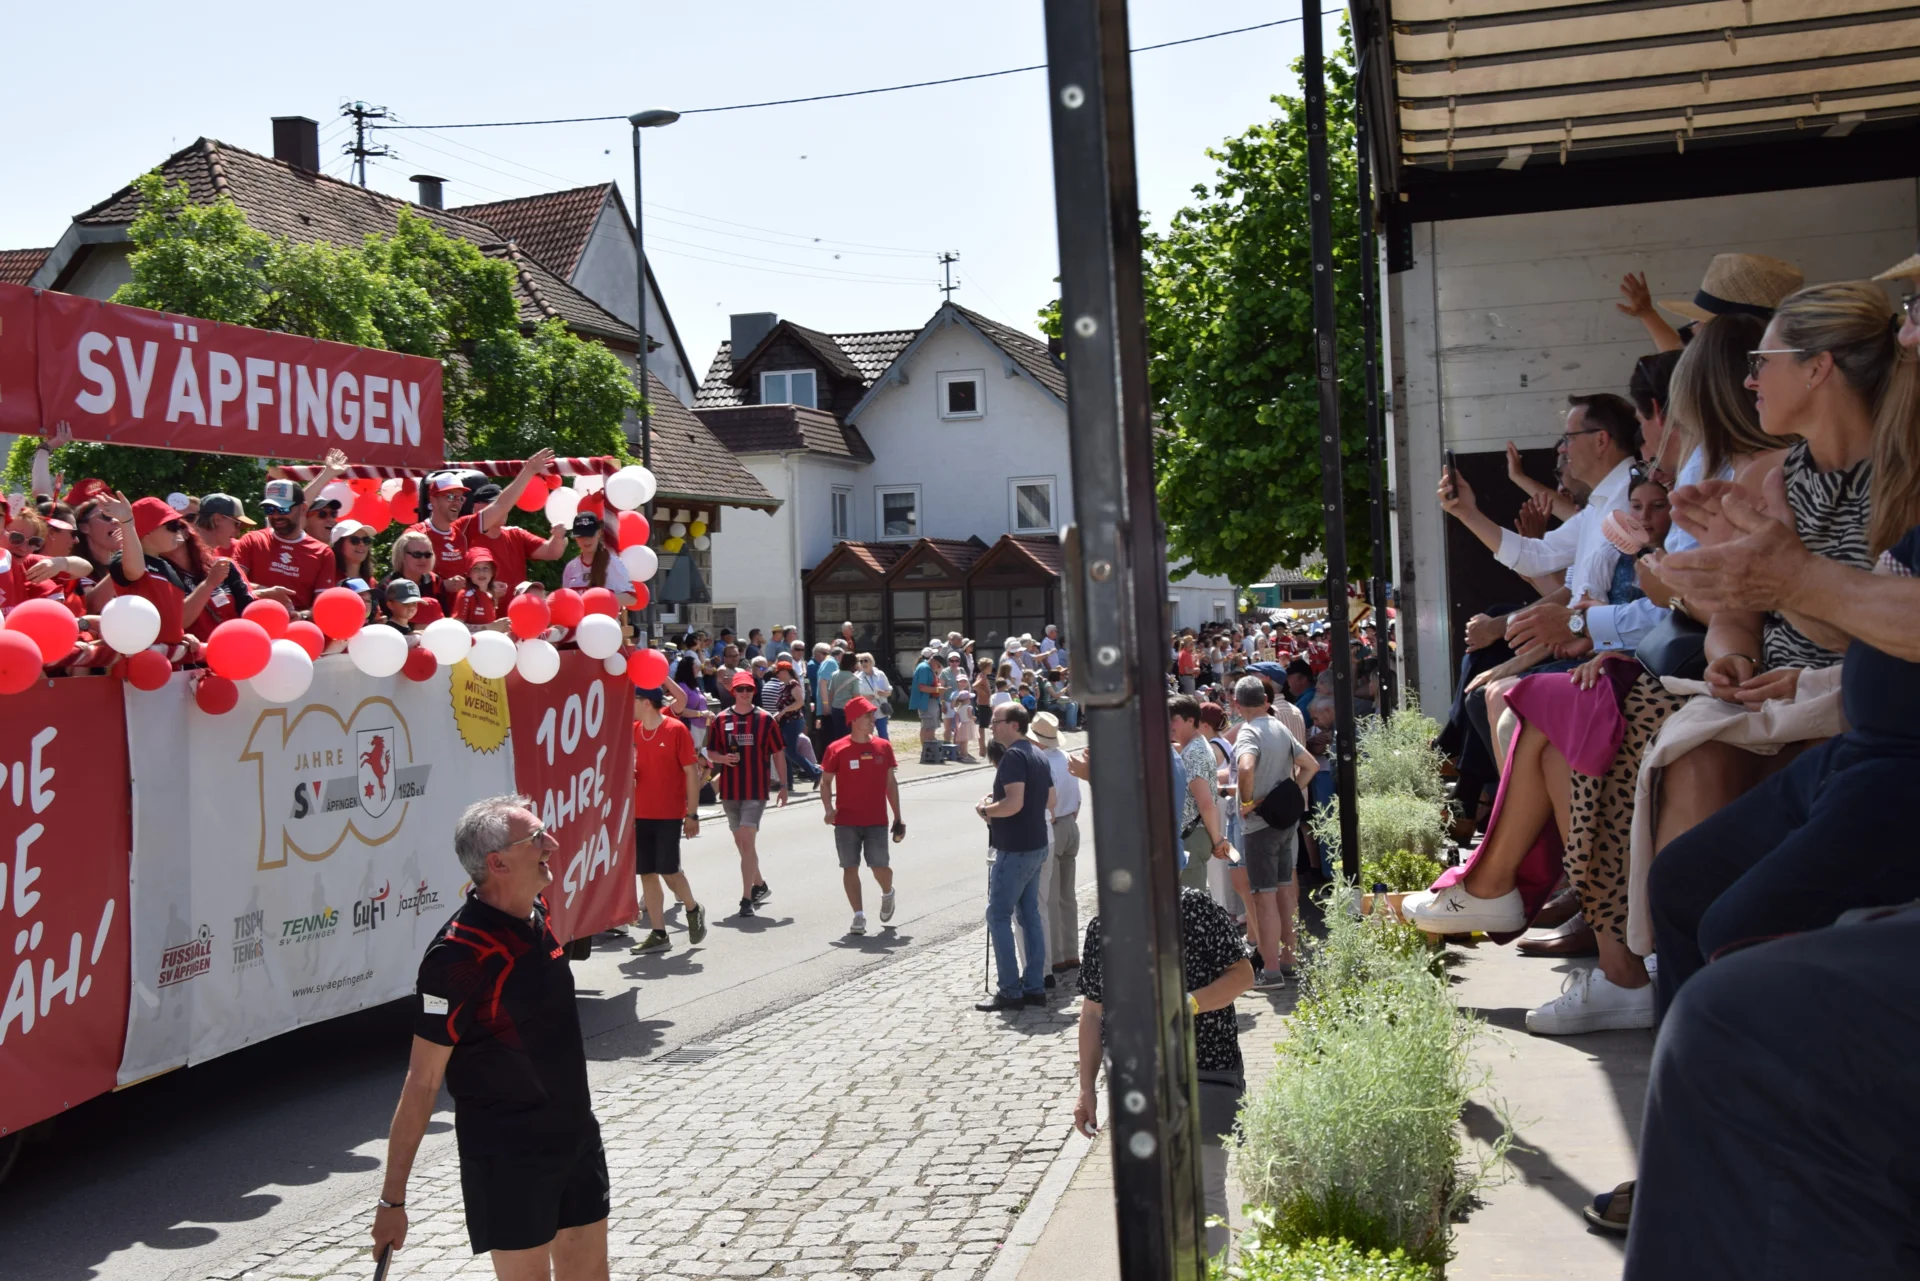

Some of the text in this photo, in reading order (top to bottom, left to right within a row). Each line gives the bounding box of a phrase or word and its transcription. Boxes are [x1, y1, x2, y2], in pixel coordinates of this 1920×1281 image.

[75, 323, 421, 447] SV ÄPFINGEN
[271, 561, 299, 573] SUZUKI
[464, 695, 498, 717] WERDEN
[536, 679, 605, 766] 100
[294, 748, 344, 771] JAHRE
[238, 695, 413, 871] 100
[398, 781, 415, 799] 1926
[326, 796, 358, 813] ÄPFINGEN
[563, 797, 630, 909] SVÄ!
[234, 909, 264, 940] TISCH
[279, 938, 292, 947] SV
[295, 928, 337, 944] ÄPFINGEN
[159, 969, 174, 984] SV
[292, 969, 374, 998] www.sv-aepfingen.de
